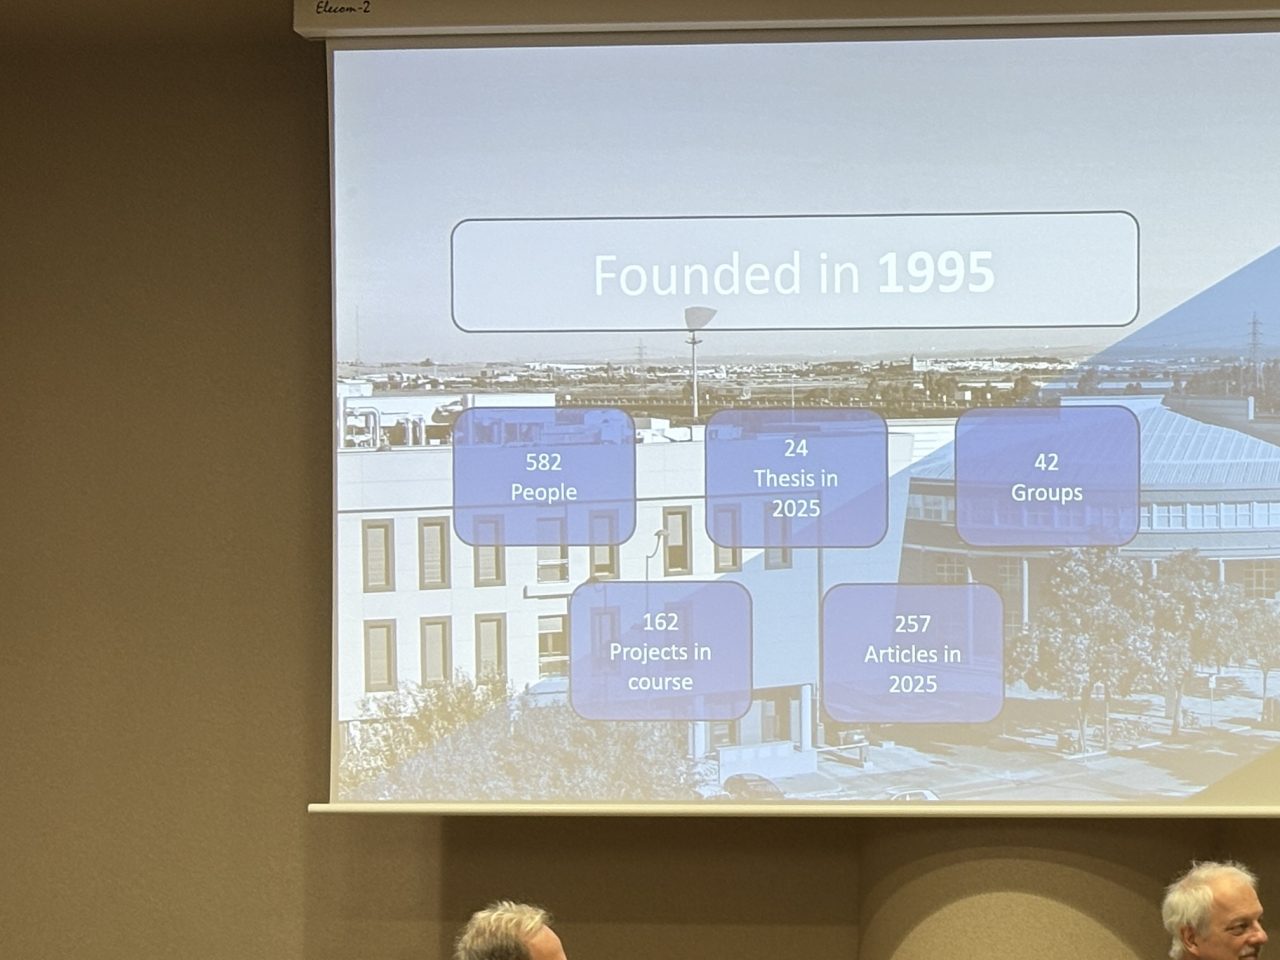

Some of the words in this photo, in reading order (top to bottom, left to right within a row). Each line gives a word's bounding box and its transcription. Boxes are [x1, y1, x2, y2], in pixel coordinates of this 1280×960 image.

[594, 252, 801, 296] Founded
[820, 252, 860, 294] in
[878, 251, 995, 293] 1995
[784, 438, 808, 458] 24
[525, 453, 562, 473] 582
[1034, 453, 1059, 473] 42
[753, 468, 813, 488] Thesis
[821, 468, 838, 487] in
[511, 483, 577, 505] People
[1011, 483, 1083, 506] Groups
[772, 499, 821, 519] 2025
[643, 614, 679, 633] 162
[895, 615, 931, 635] 257
[610, 643, 686, 666] Projects
[693, 643, 711, 662] in
[864, 645, 937, 666] Articles
[944, 645, 961, 664] in
[628, 677, 693, 693] course
[889, 675, 938, 695] 2025
